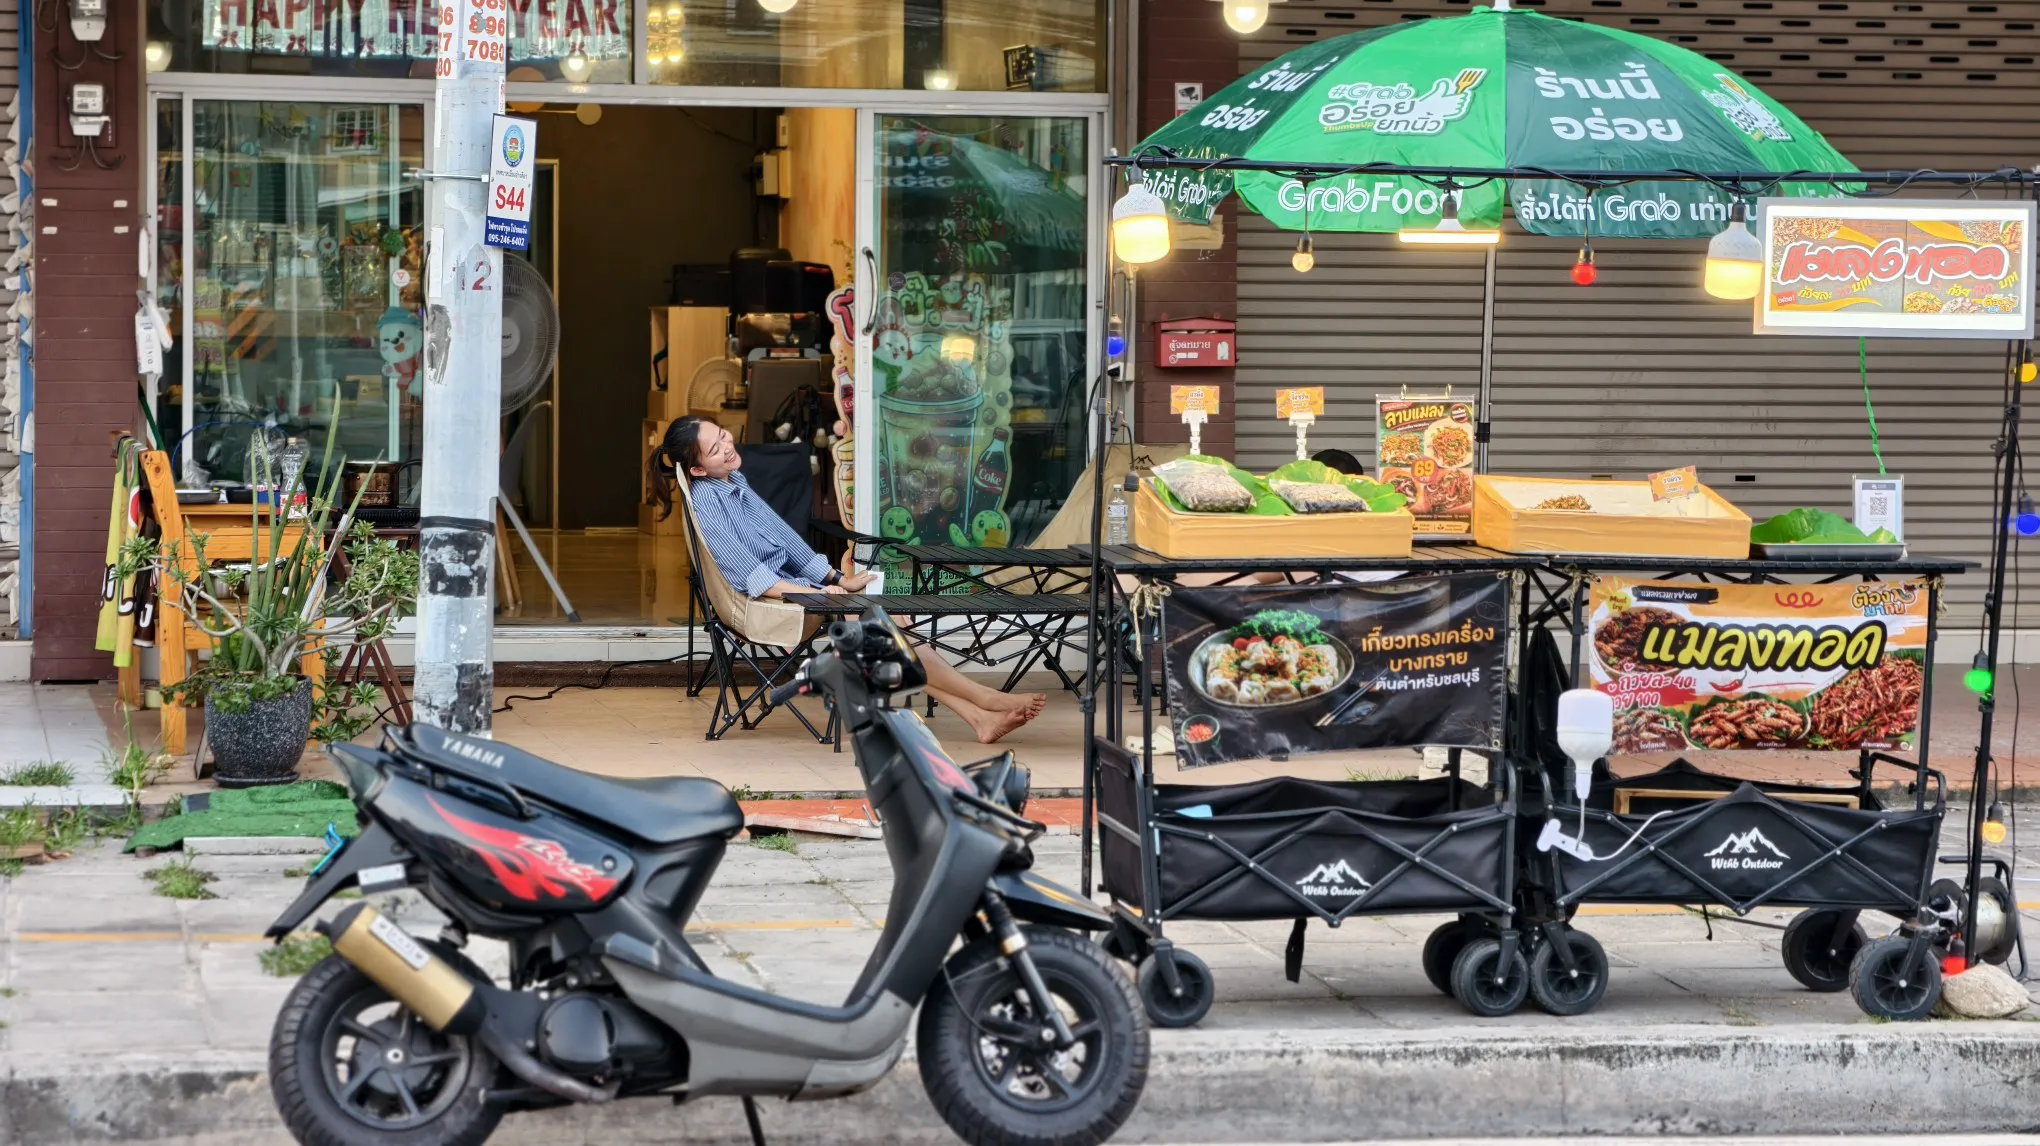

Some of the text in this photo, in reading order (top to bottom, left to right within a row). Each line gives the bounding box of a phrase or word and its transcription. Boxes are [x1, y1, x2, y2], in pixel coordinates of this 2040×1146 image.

[467, 39, 505, 62] 7080
[1331, 83, 1413, 100] #Grab
[1533, 61, 1662, 100] ร้านนี้
[1200, 97, 1271, 132] อร่อย
[1321, 101, 1416, 123] อร่อย
[1378, 112, 1442, 133] ยกนิ้ว
[1549, 107, 1684, 142] อร่อย
[495, 184, 525, 213] S44
[1603, 192, 1682, 222] Grab
[1384, 404, 1445, 430] ลาบแมลง
[978, 466, 1002, 486] Coke
[1413, 460, 1435, 477] 69
[1609, 595, 1628, 604] Must
[1361, 616, 1495, 653] เกี๊ยวทรงเครื่อง
[1641, 623, 1884, 668] แมลงทอด
[1389, 650, 1469, 673] บางทราย
[1374, 666, 1480, 692] ต้นตำหรับชลบุรี
[1673, 675, 1692, 689] 40
[1637, 692, 1660, 707] 100
[441, 736, 506, 769] YAMAHA
[1741, 857, 1784, 870] Outdoor
[1330, 885, 1367, 897] Outdoor
